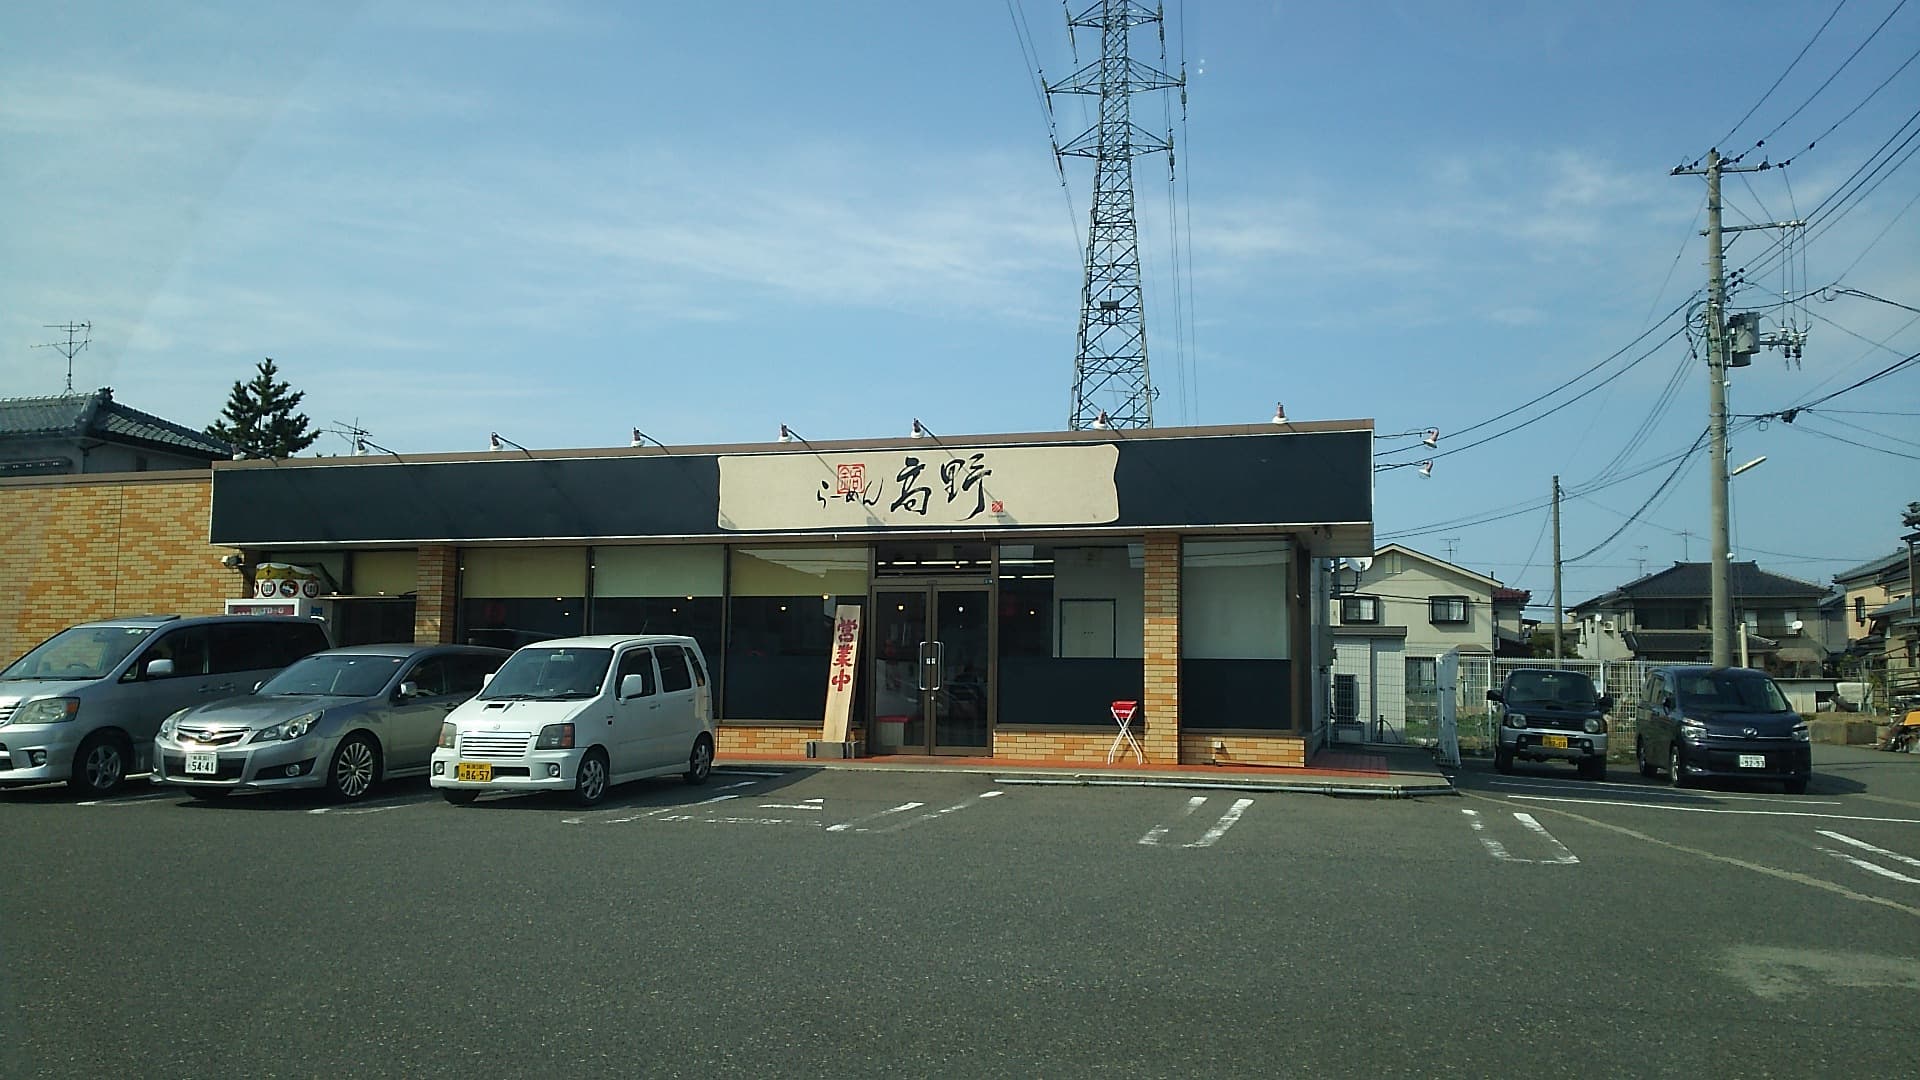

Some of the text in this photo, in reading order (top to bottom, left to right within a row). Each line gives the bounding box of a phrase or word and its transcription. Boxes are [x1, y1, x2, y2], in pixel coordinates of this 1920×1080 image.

[891, 454, 992, 521] 高野
[831, 617, 858, 692] 営業中
[465, 770, 490, 780] 86-57
